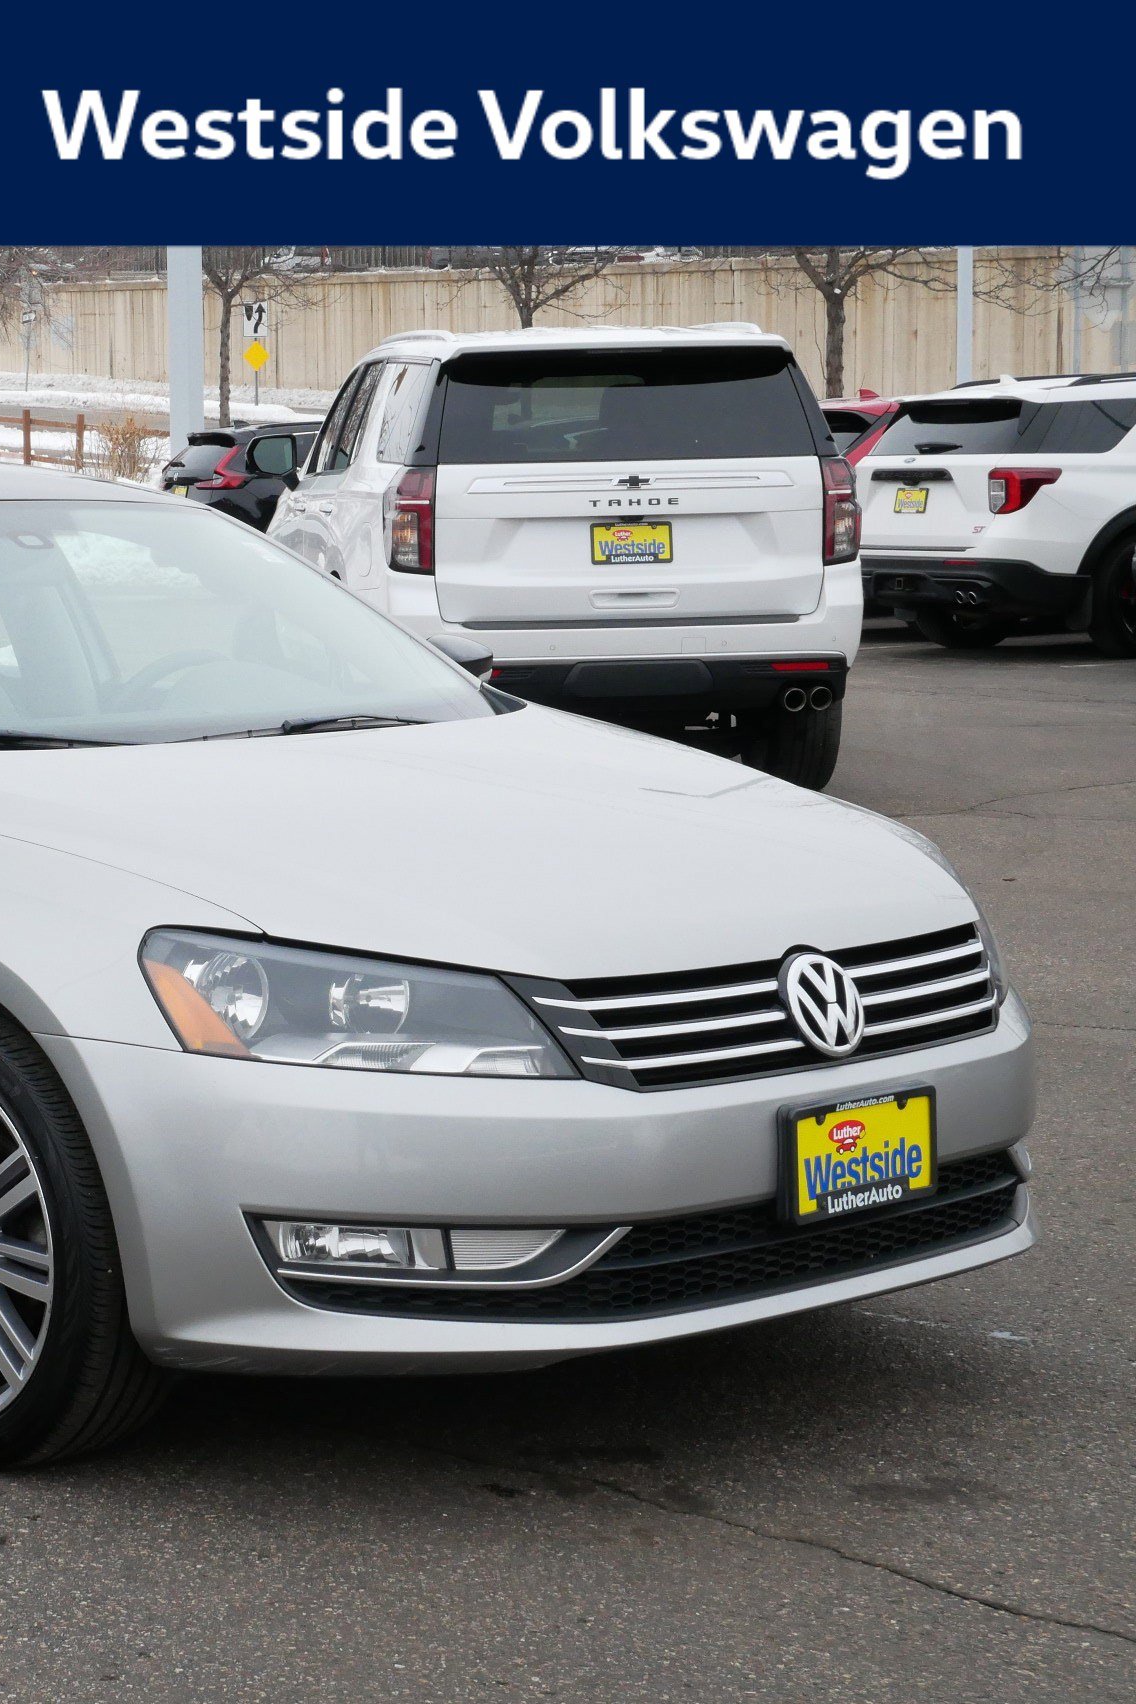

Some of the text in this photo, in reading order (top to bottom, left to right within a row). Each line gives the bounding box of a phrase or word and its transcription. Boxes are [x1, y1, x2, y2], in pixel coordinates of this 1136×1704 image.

[589, 498, 679, 507] TAHOE
[972, 526, 986, 534] ST
[598, 539, 666, 556] Westside
[611, 554, 654, 563] LutherAuto
[836, 1095, 894, 1111] LutherAuto.com
[833, 1125, 862, 1140] Luther
[804, 1137, 922, 1200] Westside
[827, 1183, 903, 1214] LutherAuto
